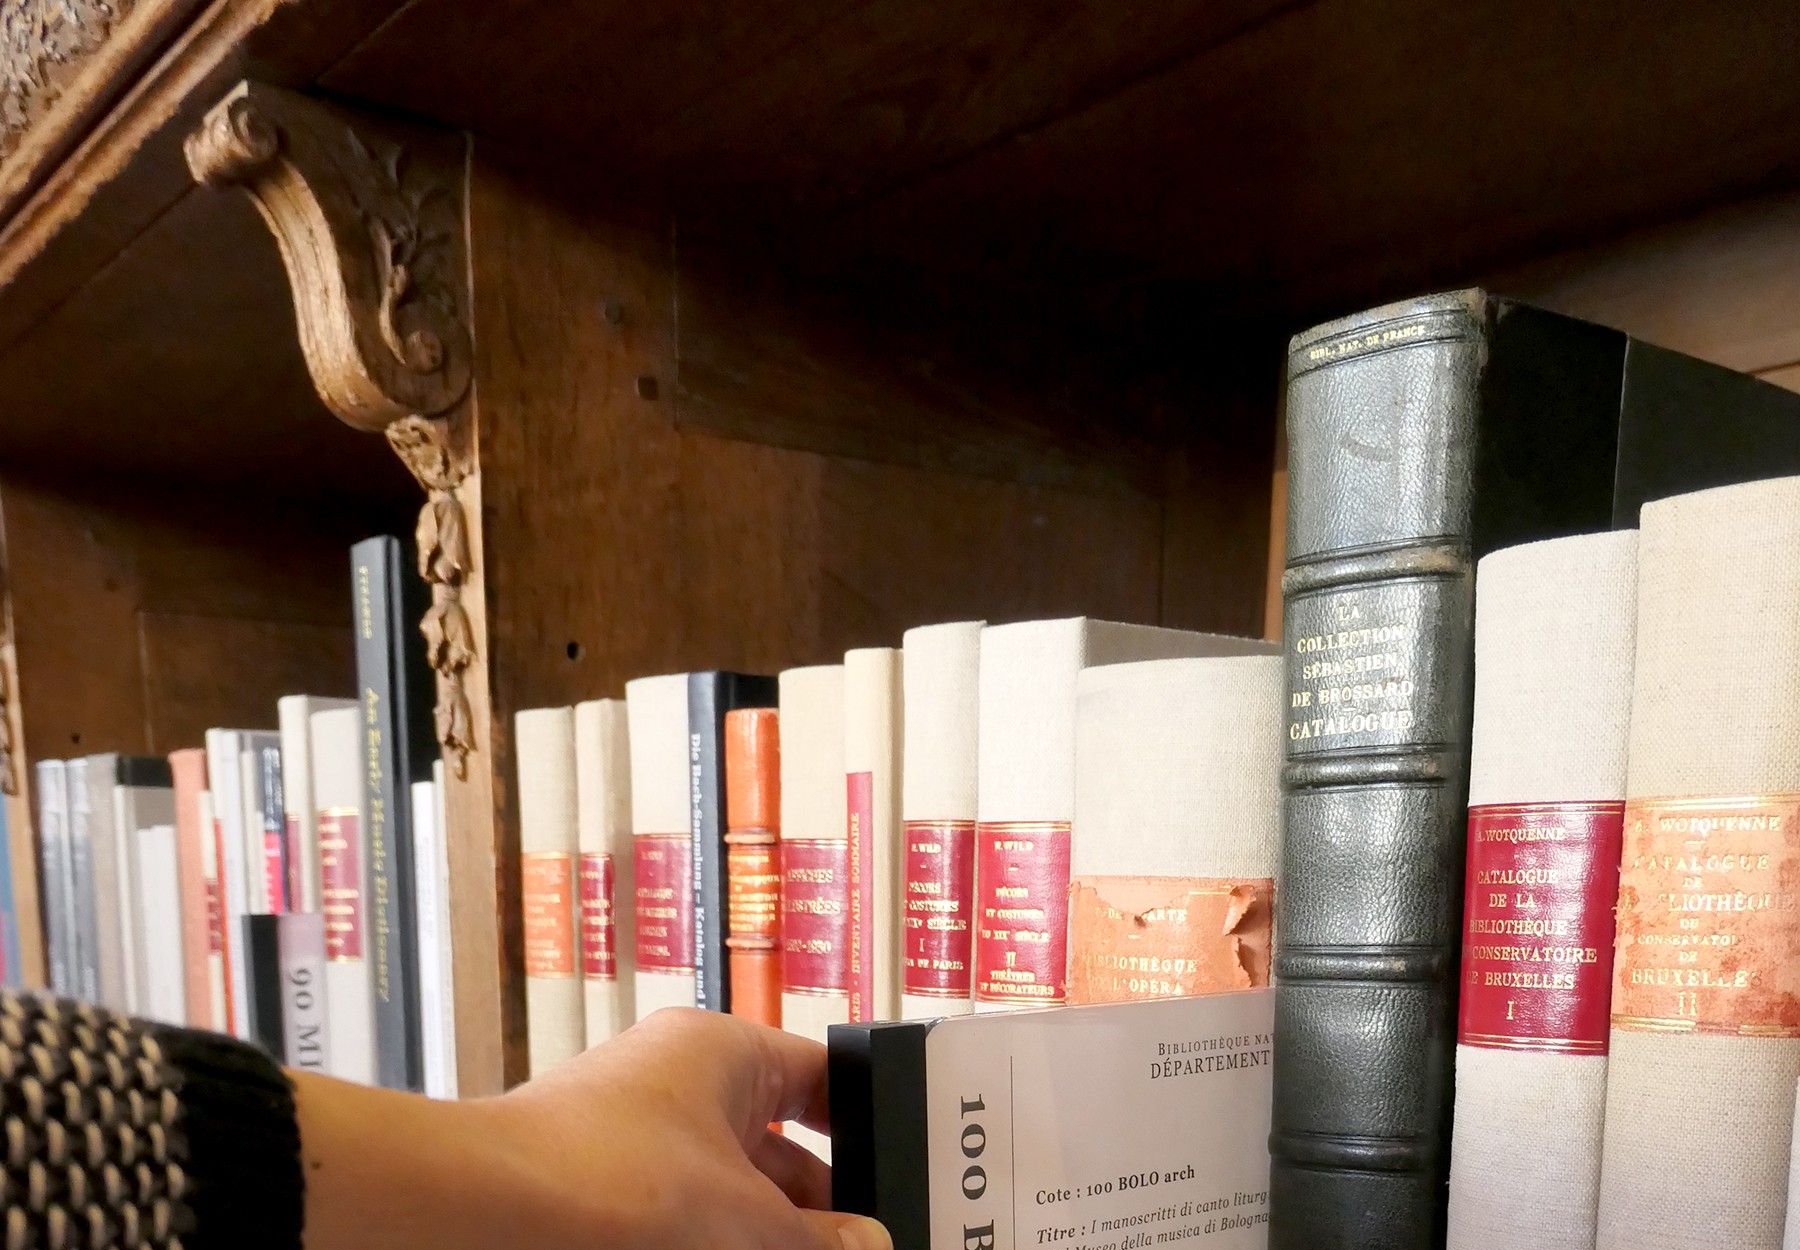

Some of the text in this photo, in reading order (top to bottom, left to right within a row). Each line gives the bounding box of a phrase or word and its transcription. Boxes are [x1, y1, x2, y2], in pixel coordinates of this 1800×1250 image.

[1383, 325, 1425, 342] FRANCE
[1338, 605, 1361, 621] LA
[1296, 624, 1405, 654] COLLECTION
[1291, 680, 1414, 708] DE BROSSARD
[1289, 710, 1414, 740] CATALOGUE
[1477, 869, 1558, 885] CATALOGUE
[1682, 877, 1704, 888] DE
[850, 812, 861, 974] INVENTAIRE SOMMAIRE
[1489, 893, 1538, 908] DE LA
[694, 907, 705, 966] Katalog
[1469, 917, 1568, 938] BIBLIOTHÈQUE
[1472, 945, 1598, 963] CONSERVATOIRE
[696, 970, 707, 1000] und
[1484, 971, 1576, 990] BRUXELLES
[850, 992, 861, 1023] ARIS
[1506, 1000, 1514, 1020] I
[1158, 1036, 1250, 1056] BIBLIOTHÈQUE
[1150, 1050, 1270, 1080] DÉPARTEMENT
[960, 1093, 987, 1201] 100
[1036, 1189, 1071, 1206] Cote
[1086, 1181, 1113, 1198] 100
[1118, 1171, 1160, 1192] BOLO
[1164, 1165, 1196, 1184] arch
[1037, 1226, 1076, 1245] Titre
[1101, 1204, 1177, 1234] manoscritti
[1180, 1201, 1193, 1217] di
[1196, 1198, 1230, 1214] canto
[1233, 1191, 1269, 1207] liturg
[1121, 1233, 1152, 1250] della
[1157, 1224, 1200, 1244] musica
[1204, 1219, 1216, 1234] di
